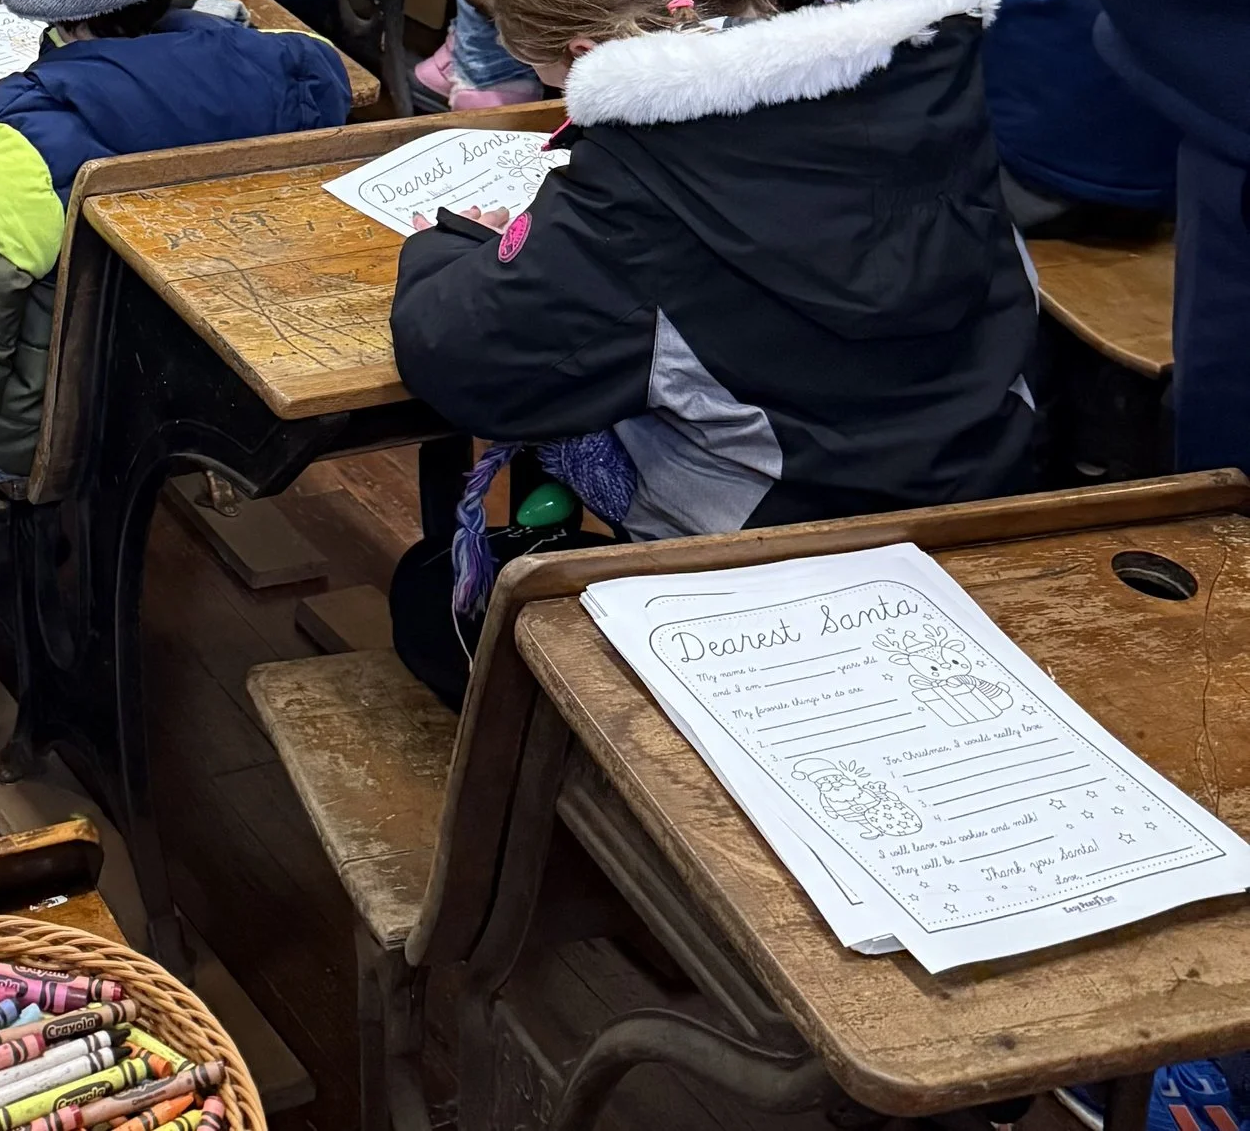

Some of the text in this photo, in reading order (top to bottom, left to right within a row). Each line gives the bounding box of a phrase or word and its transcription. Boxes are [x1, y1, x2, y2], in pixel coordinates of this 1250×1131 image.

[371, 132, 520, 204] Dearest Santa
[671, 595, 918, 663] Dearest Santa
[696, 673, 717, 684] My
[719, 669, 746, 679] name
[837, 662, 861, 675] years
[712, 684, 761, 699] and I am
[732, 709, 753, 720] My
[755, 702, 790, 718] favorite
[791, 696, 820, 711] things
[822, 691, 832, 701] to
[834, 689, 845, 698] do
[882, 756, 903, 767] For
[953, 740, 961, 749] I
[964, 734, 991, 746] would
[993, 727, 1022, 740] really
[878, 812, 1039, 859] I will leave out cookies and milk!
[892, 864, 919, 877] They
[921, 857, 942, 870] will
[980, 838, 1100, 882] Thank you Santa!
[46, 1016, 97, 1038] Crayola
[55, 1085, 107, 1110] Crayola
